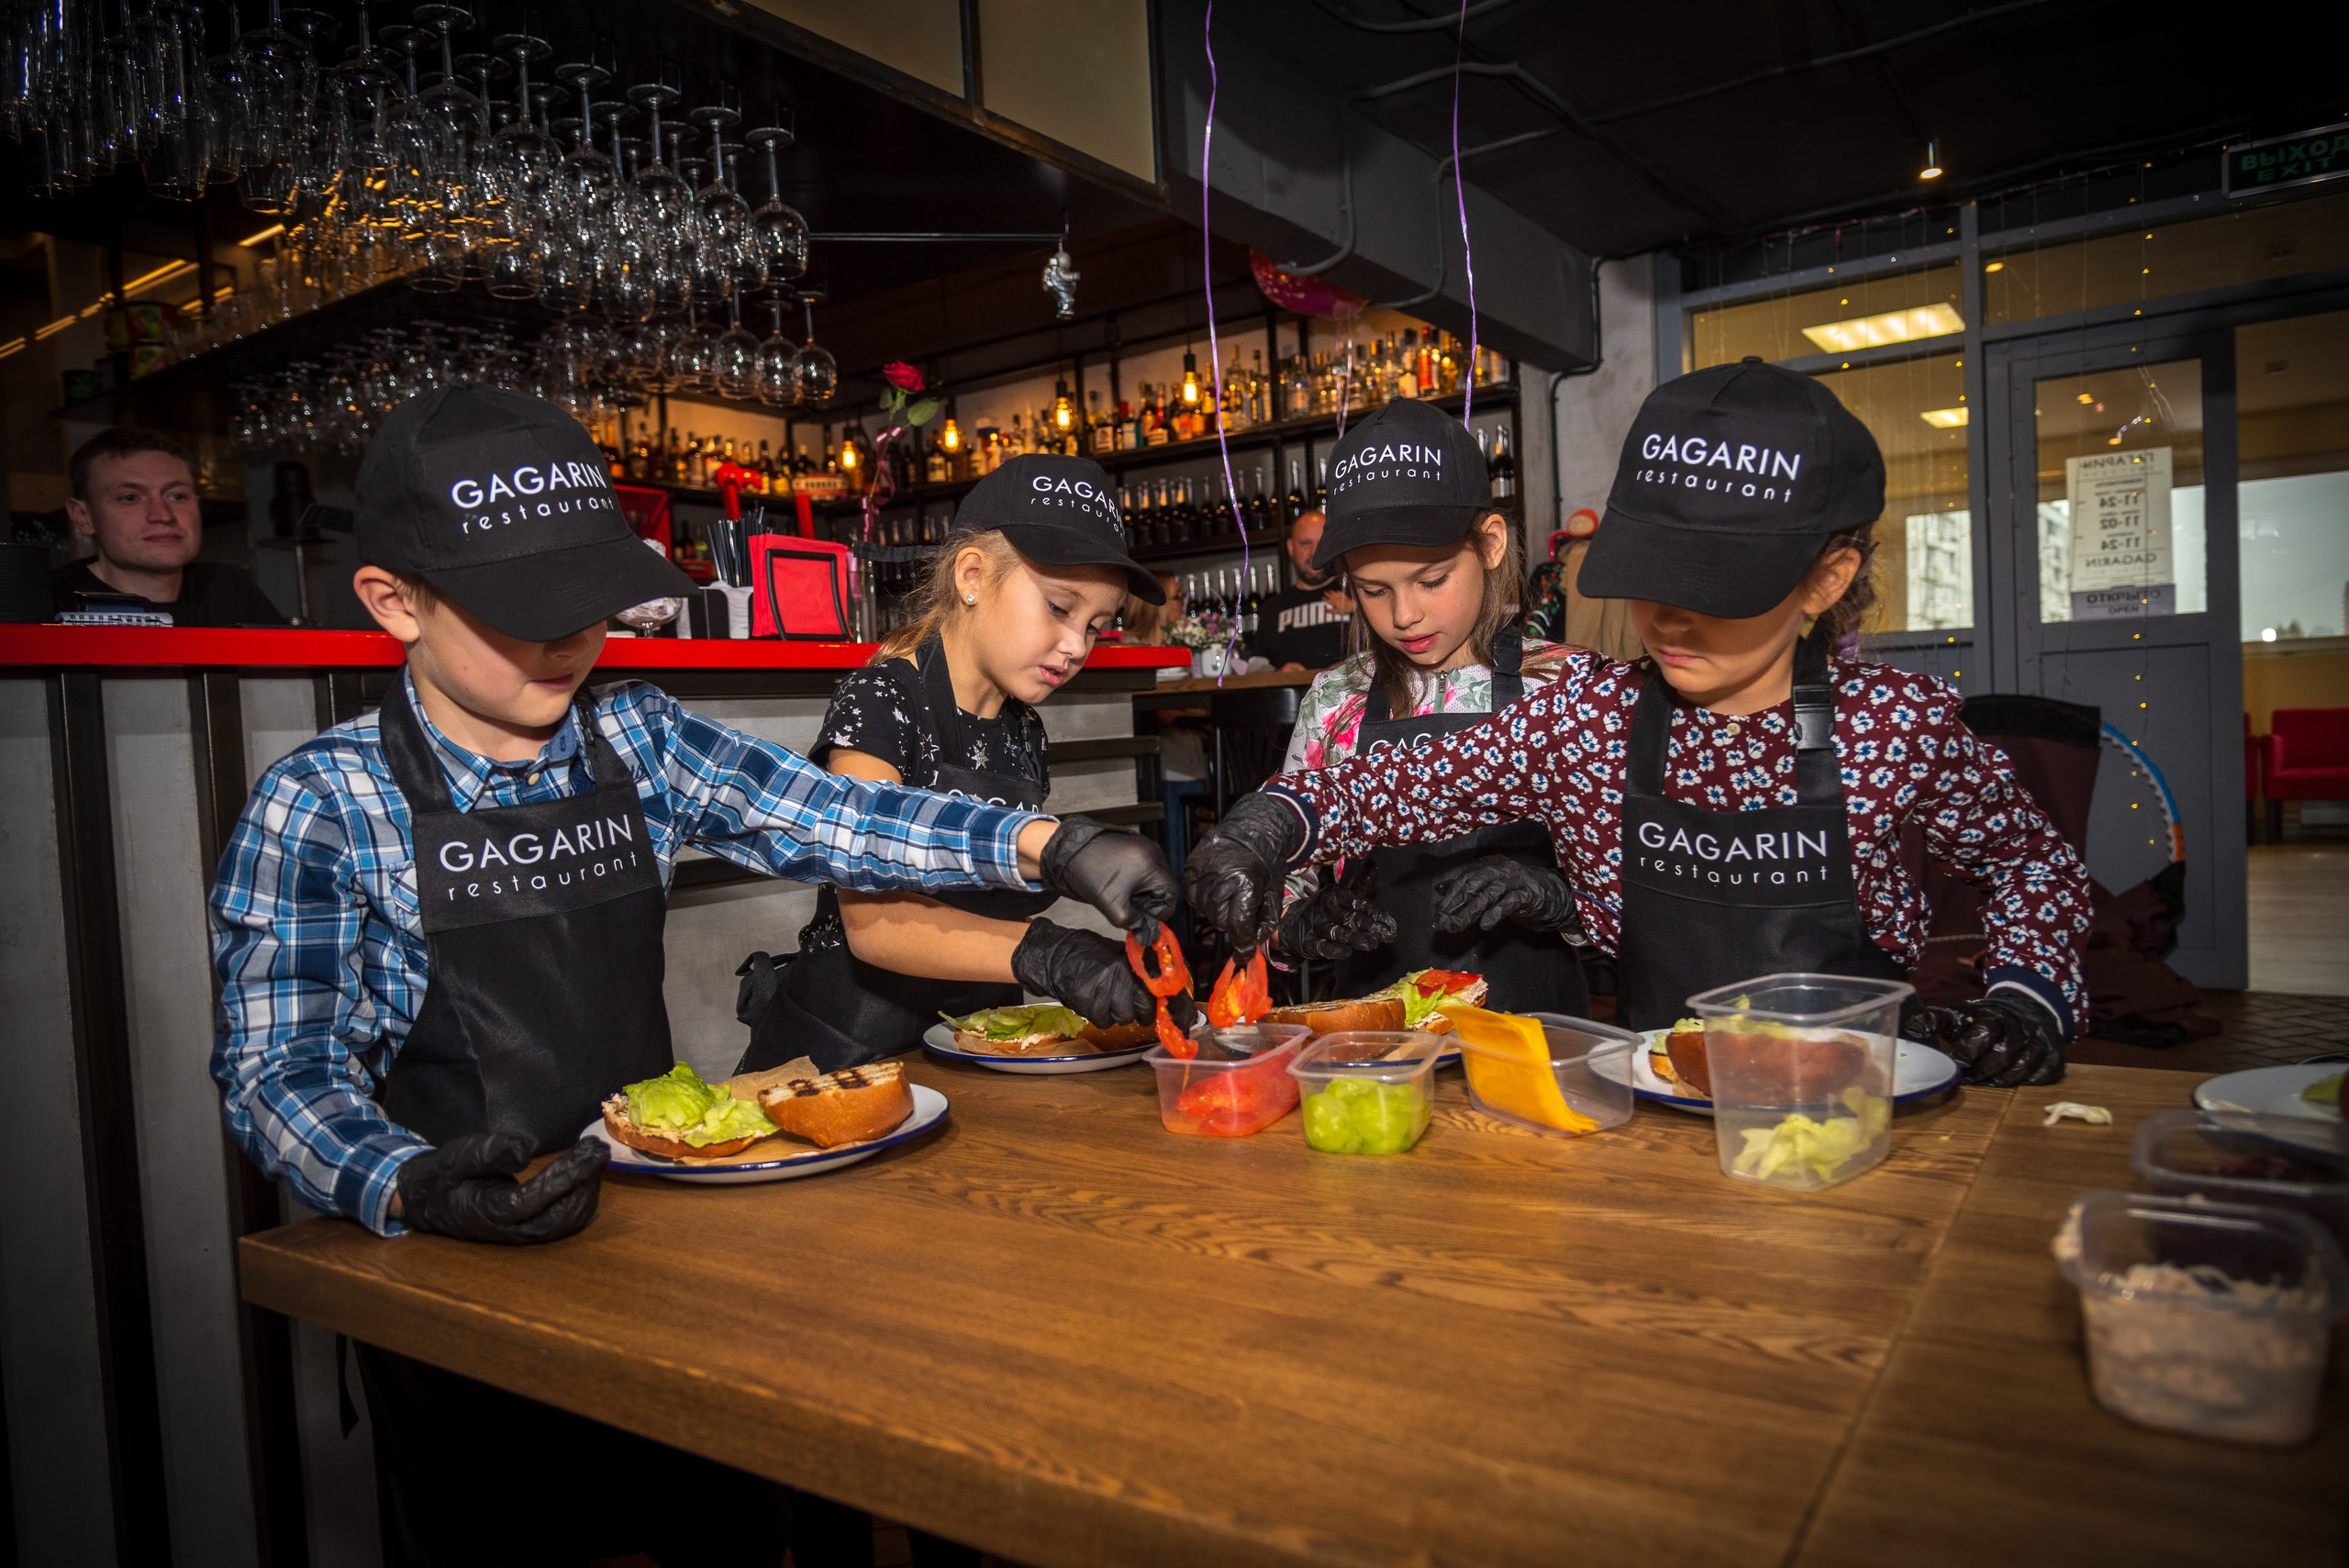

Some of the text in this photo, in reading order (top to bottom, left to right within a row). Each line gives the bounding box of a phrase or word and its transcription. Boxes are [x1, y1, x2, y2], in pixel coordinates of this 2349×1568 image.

[2242, 135, 2349, 171] ВЫХОД
[2257, 156, 2335, 182] EXIT
[1335, 444, 1442, 479] GAGARIN
[1642, 433, 1800, 481] GAGARIN
[451, 462, 607, 508] GAGARIN
[1333, 469, 1441, 495] restaurant
[1636, 470, 1791, 503] restaurant
[462, 495, 614, 534] restaurant
[1030, 497, 1124, 541] restaura
[440, 814, 633, 872] GAGARIN
[1639, 821, 1828, 862] GAGARIN
[448, 851, 637, 901] restaurant
[1640, 856, 1827, 884] restaurant
